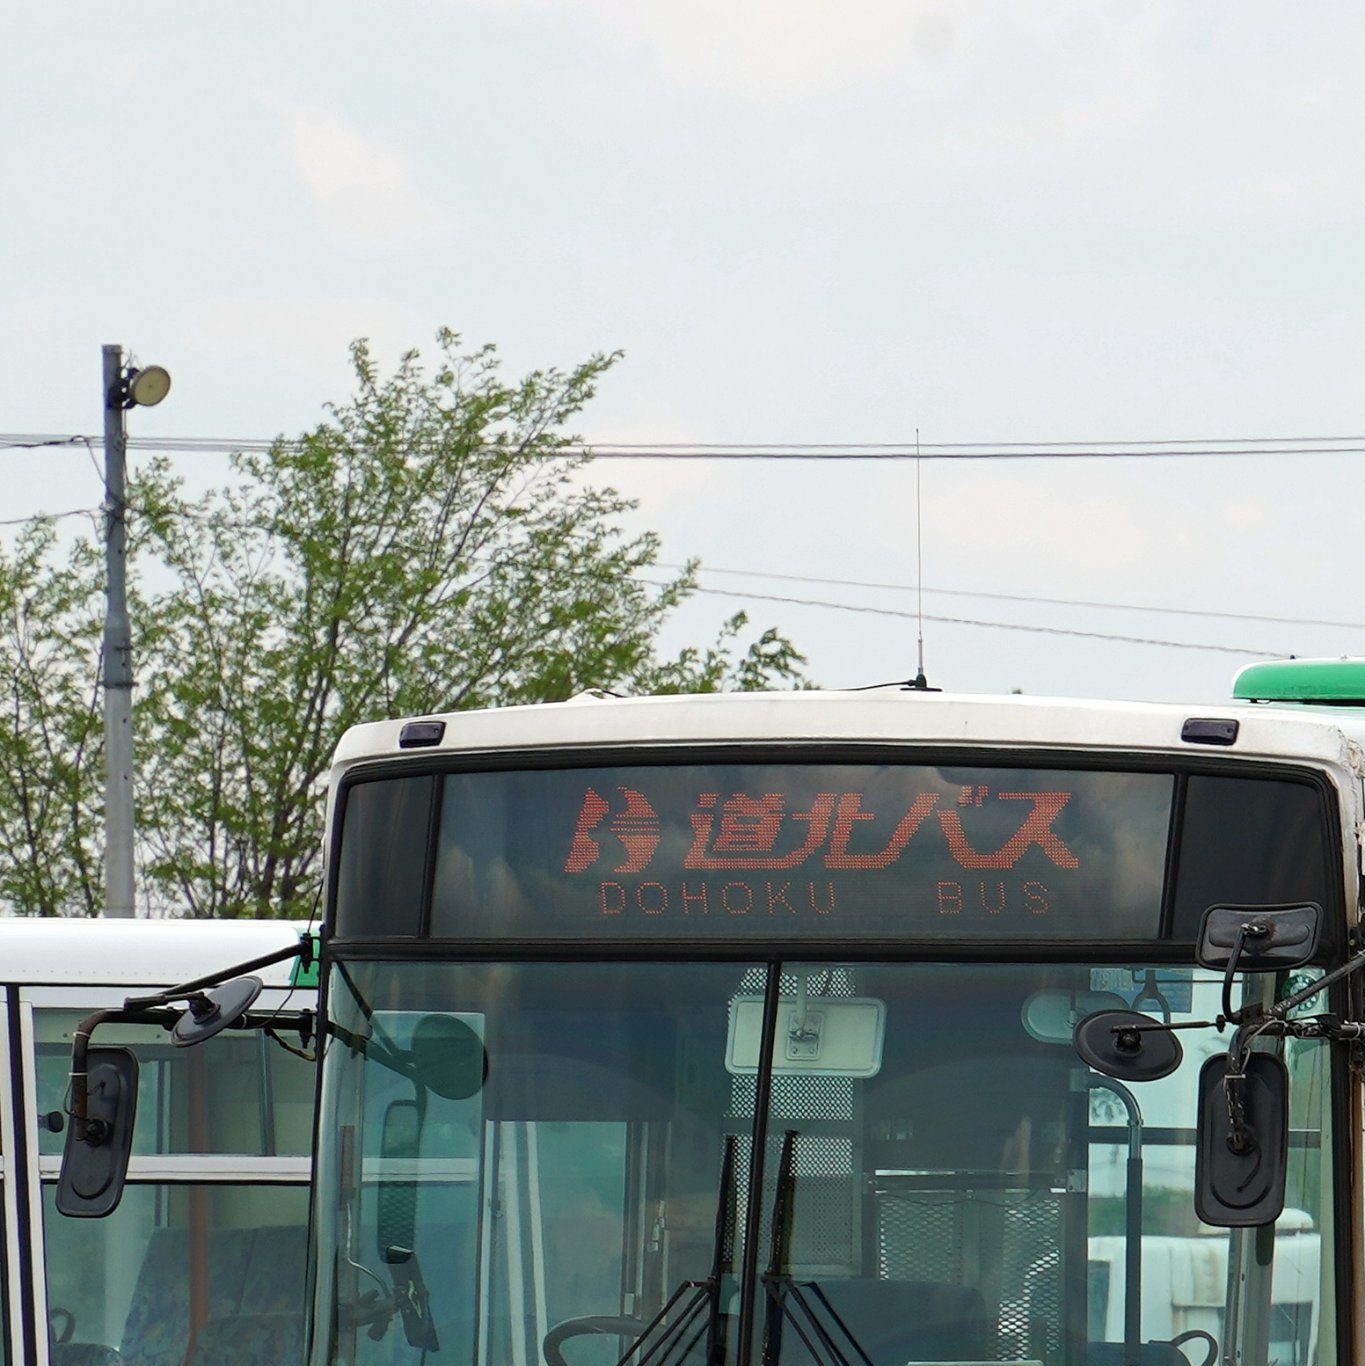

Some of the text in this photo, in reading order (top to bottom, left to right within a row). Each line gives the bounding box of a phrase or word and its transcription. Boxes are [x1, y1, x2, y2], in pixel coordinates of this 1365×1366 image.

[684, 784, 1079, 870] 道北バス
[601, 881, 1050, 916] DOHOKU BUS
